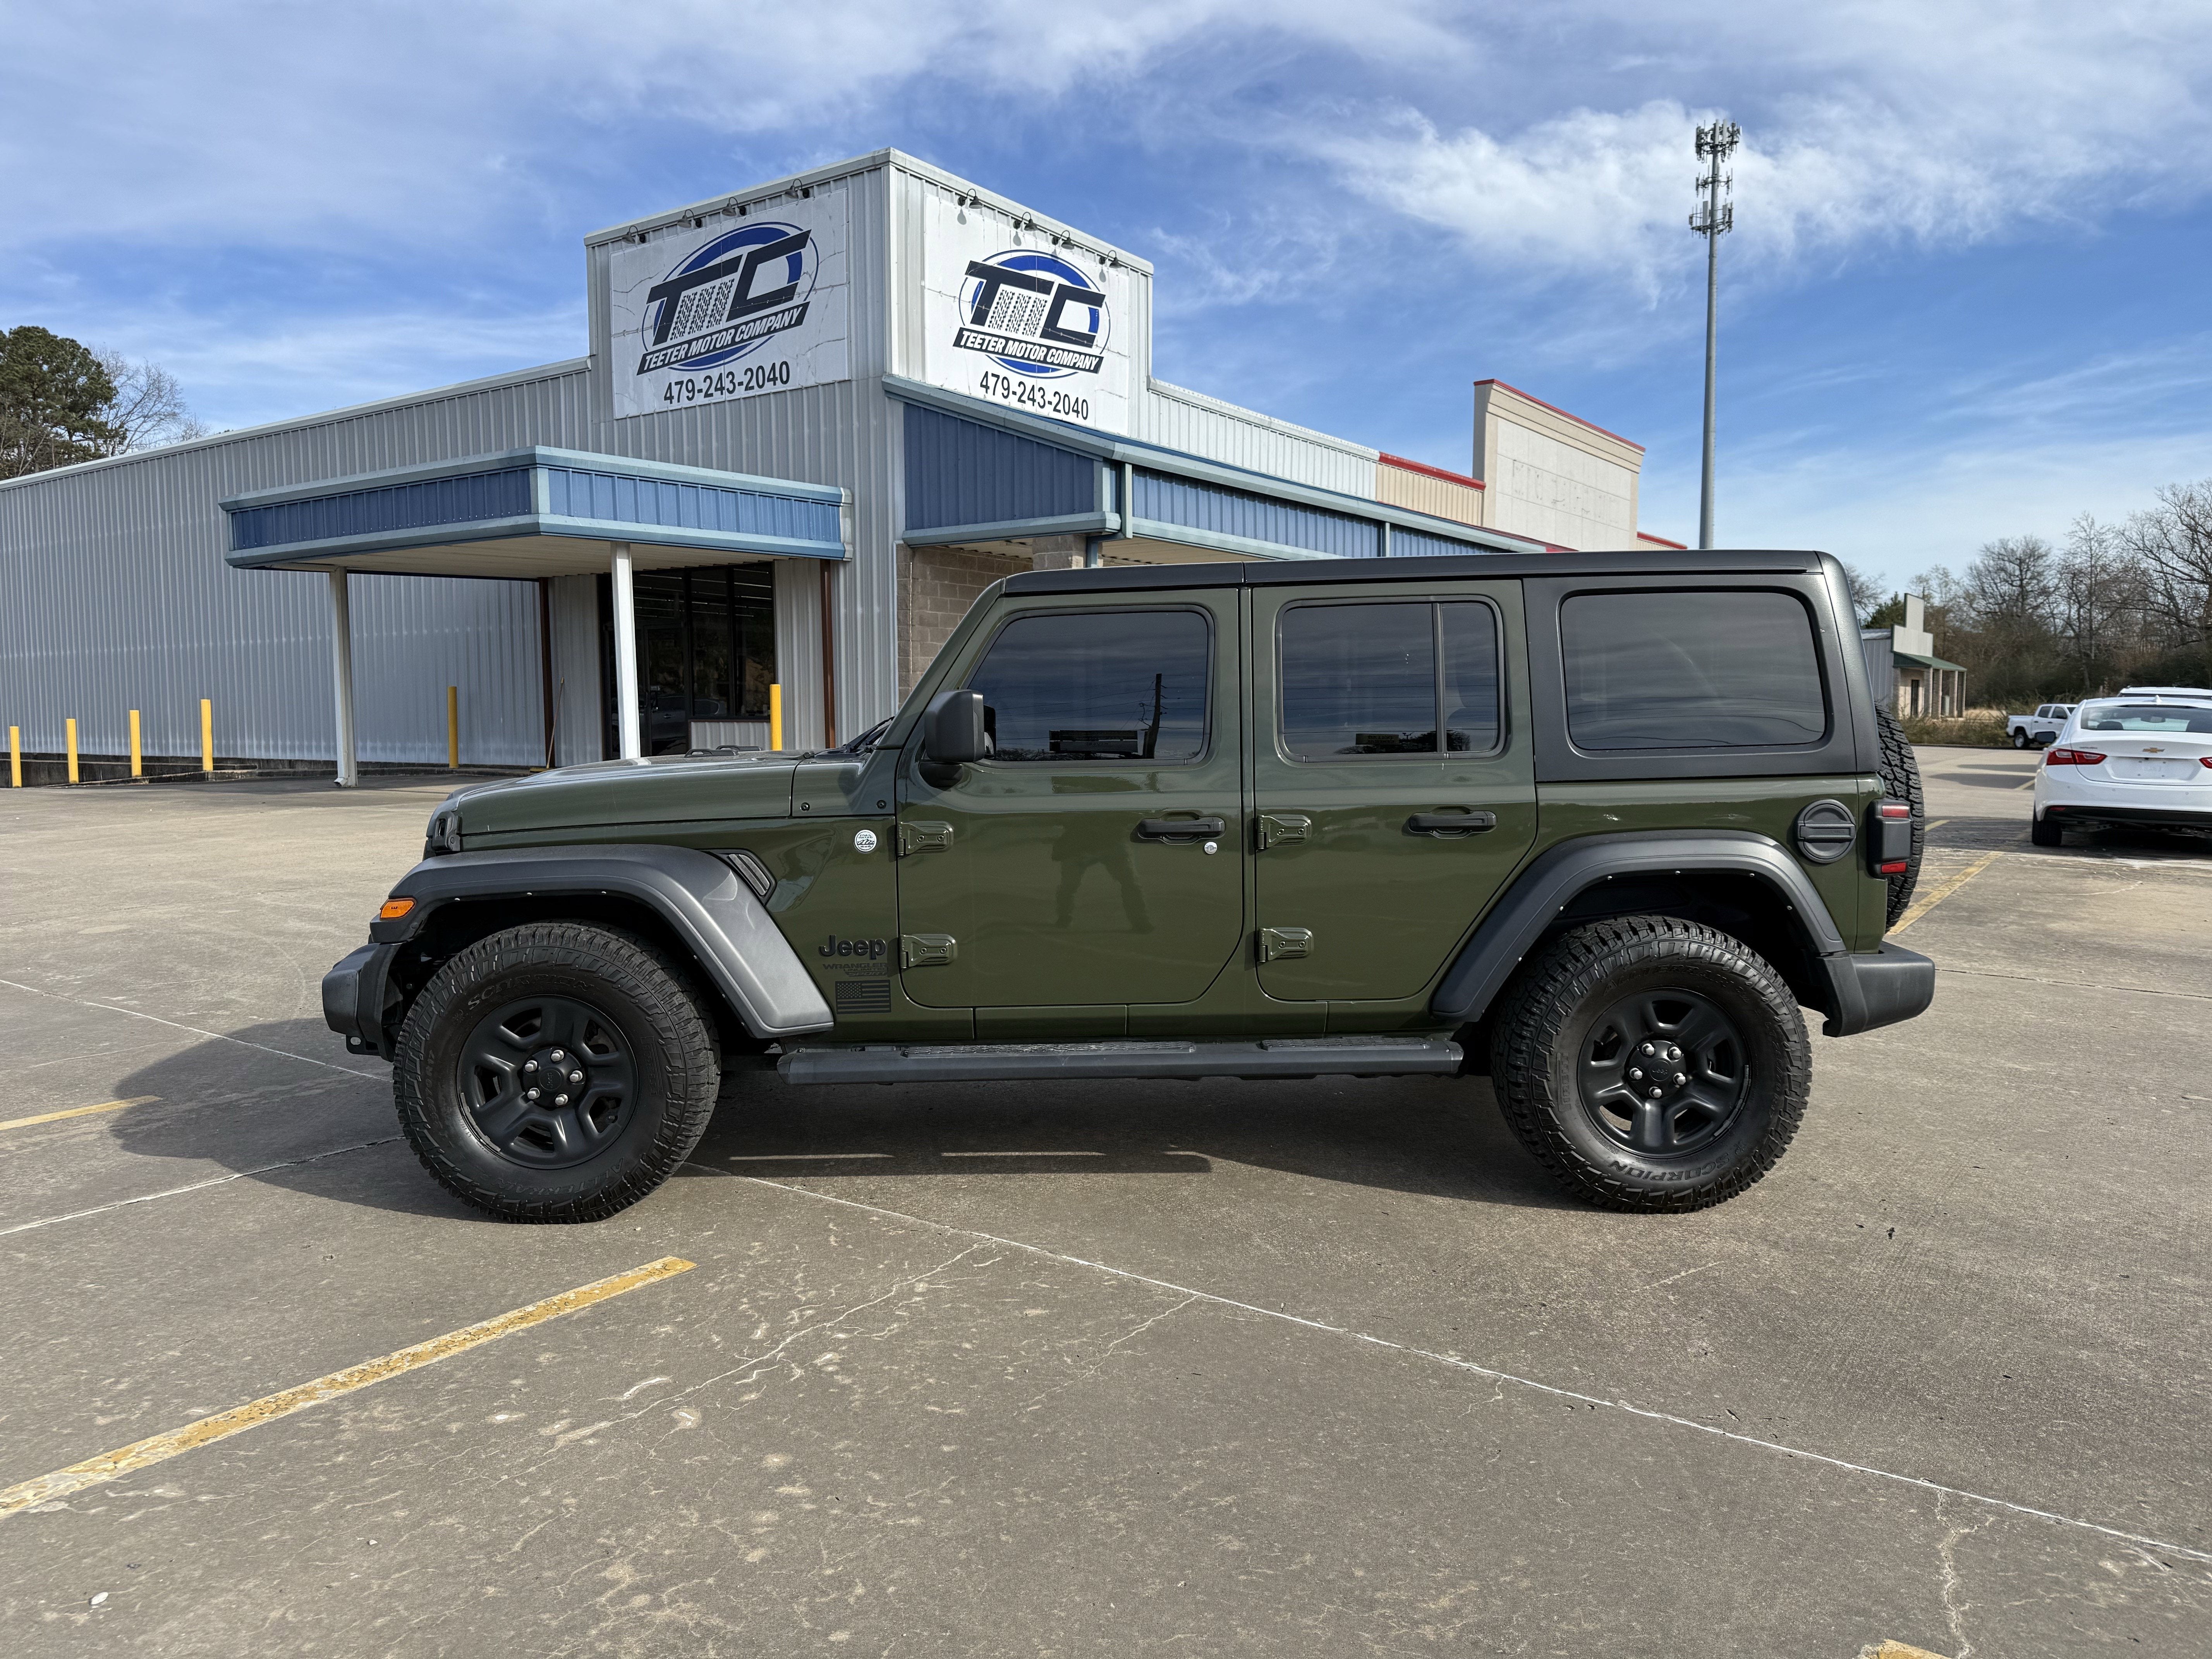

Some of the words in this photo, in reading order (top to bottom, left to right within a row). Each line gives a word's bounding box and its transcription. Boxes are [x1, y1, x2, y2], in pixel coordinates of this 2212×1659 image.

[644, 345, 689, 371] TEETER
[688, 331, 733, 356] MOTOR
[735, 306, 803, 342] COMPANY
[960, 331, 1007, 352] TEETER
[1005, 341, 1048, 361] MOTOR
[1046, 349, 1099, 371] COMPANY
[663, 361, 790, 405] 479-243-2040
[980, 371, 1089, 421] 479-243-2040
[819, 934, 886, 960] Jeep
[1608, 1152, 1730, 1182] SCORPION
